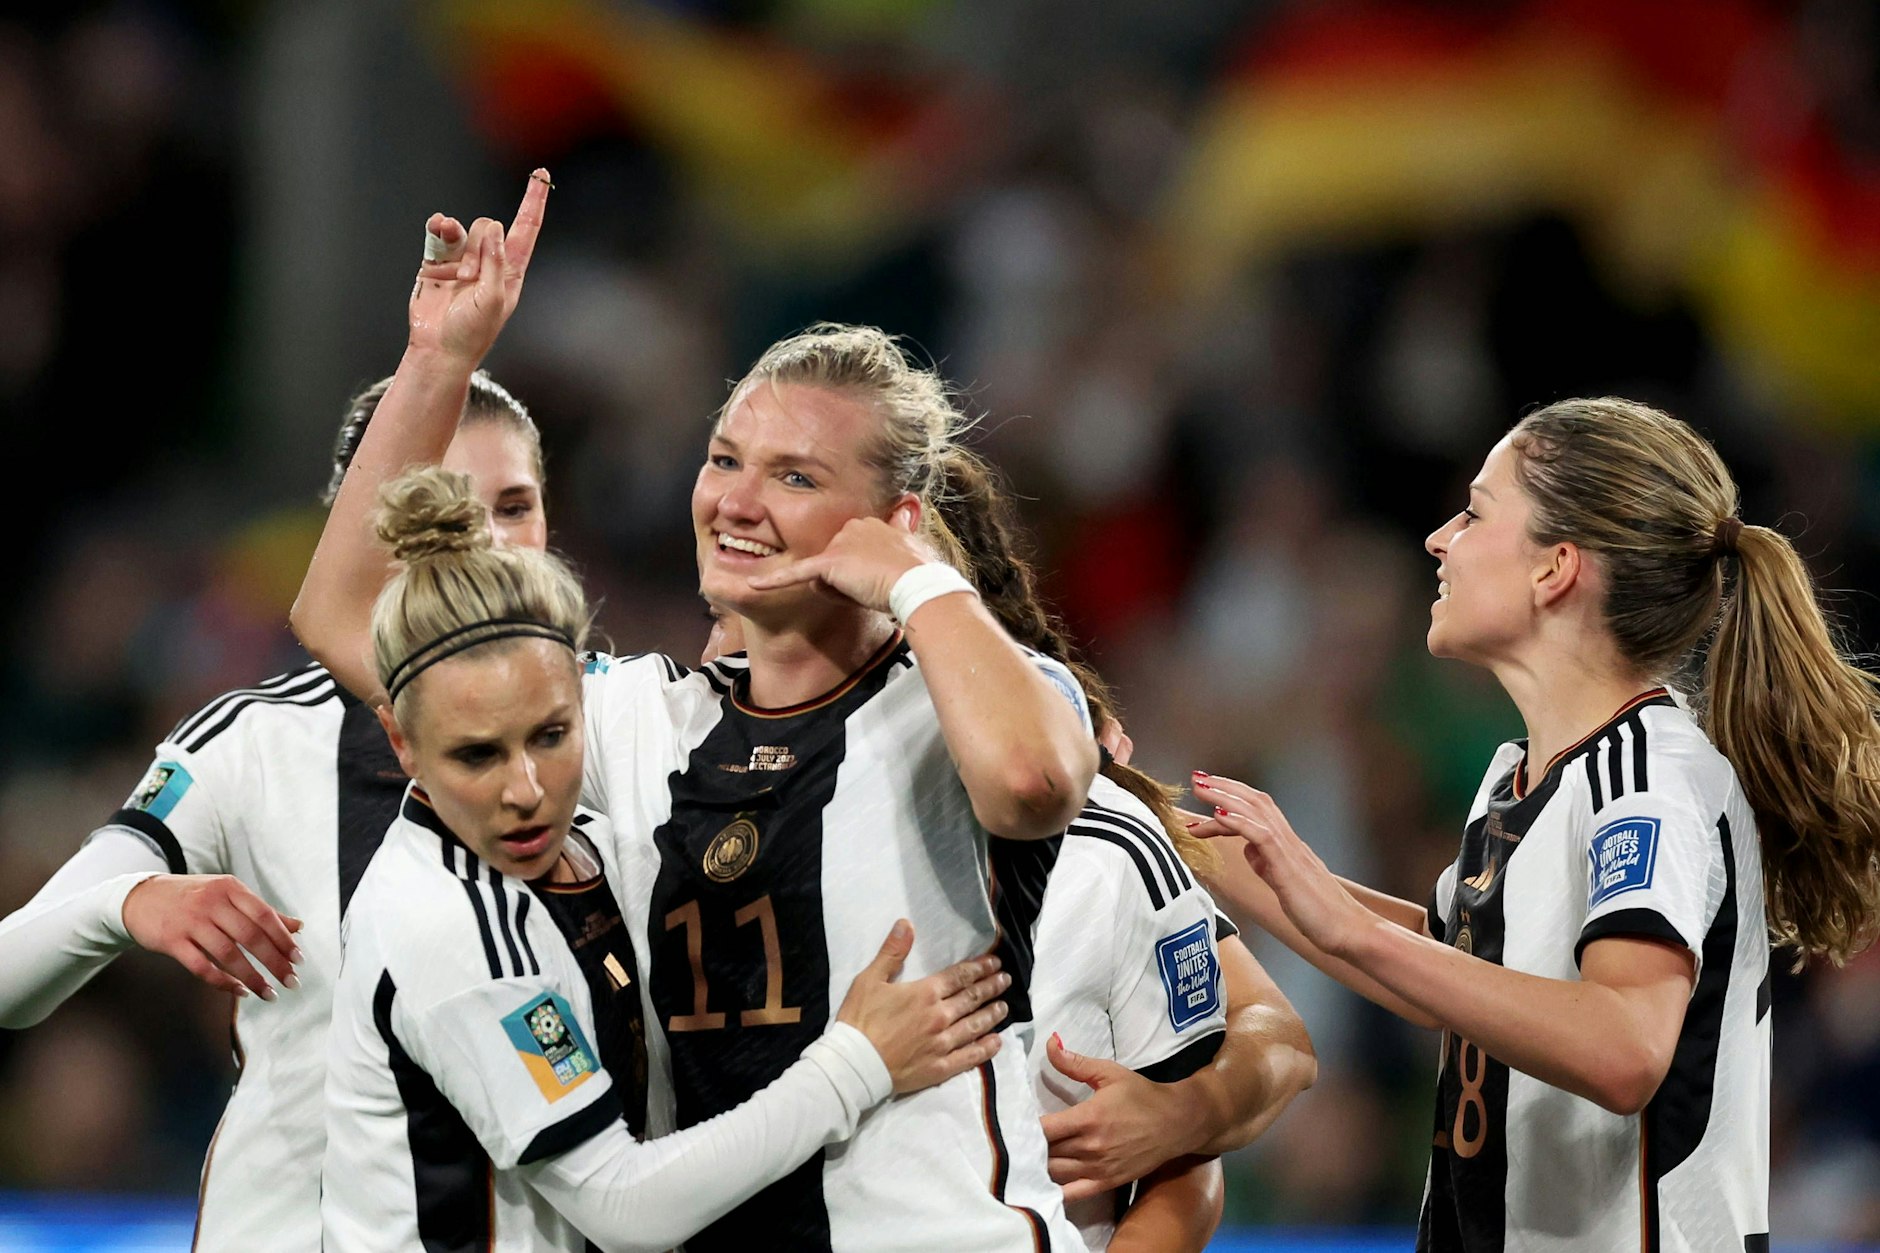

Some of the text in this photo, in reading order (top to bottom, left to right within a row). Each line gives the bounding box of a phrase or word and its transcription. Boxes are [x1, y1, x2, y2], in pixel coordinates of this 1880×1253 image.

[753, 746, 788, 754] MOROCCO
[756, 754, 775, 762] JULY
[1600, 840, 1639, 867] UNITES
[1606, 874, 1622, 885] FIFA
[665, 895, 801, 1031] 11
[1173, 938, 1208, 963] FOOTBALL
[1177, 951, 1209, 980] UNITES
[1176, 966, 1210, 996] the World
[1190, 992, 1205, 1005] FIFA
